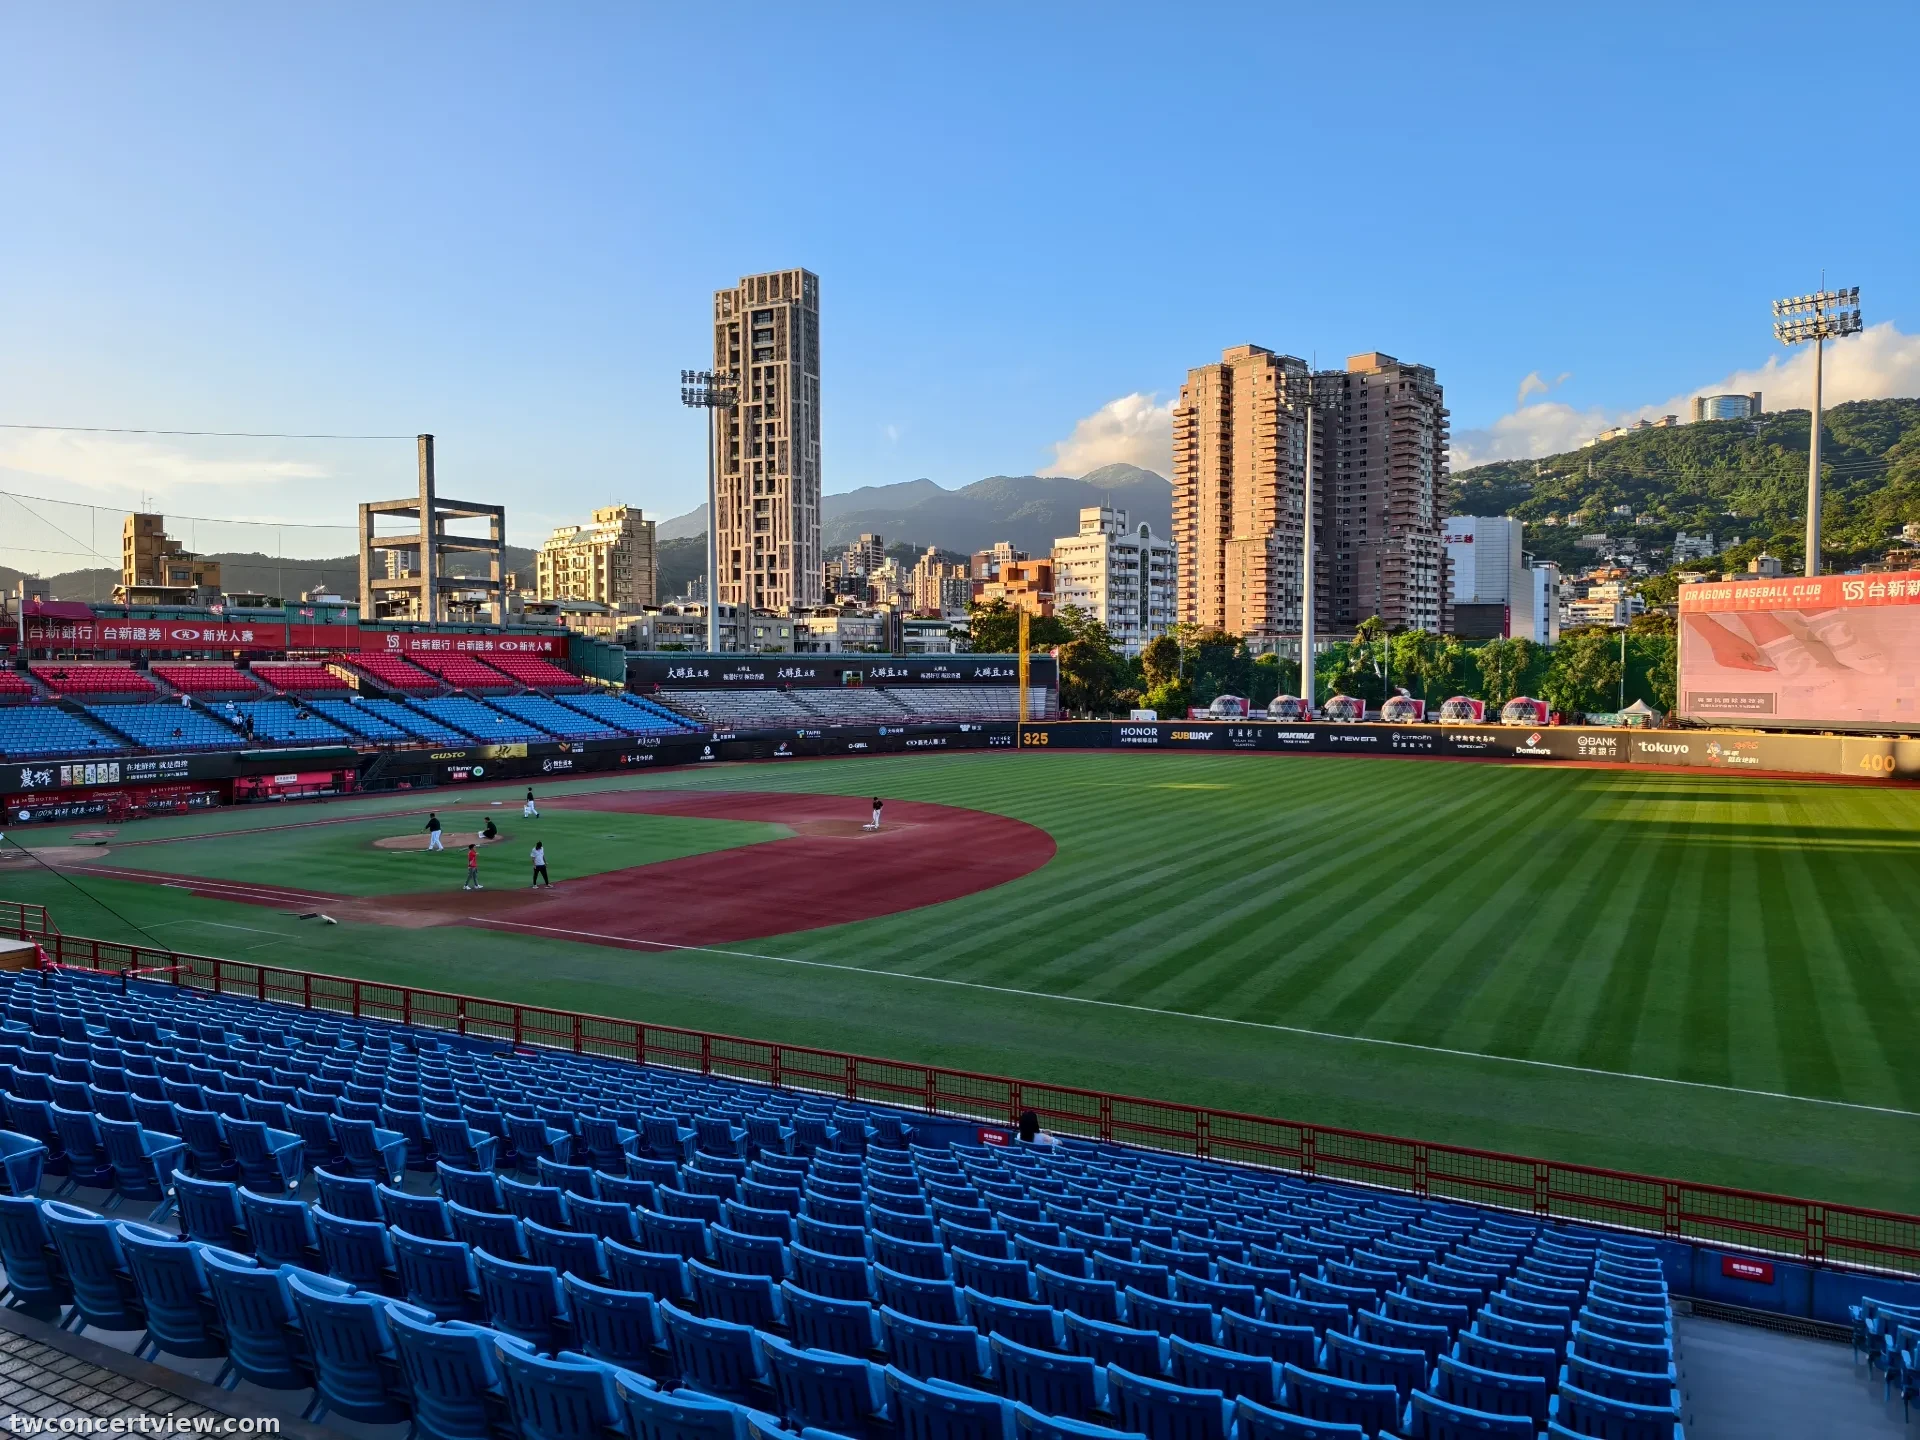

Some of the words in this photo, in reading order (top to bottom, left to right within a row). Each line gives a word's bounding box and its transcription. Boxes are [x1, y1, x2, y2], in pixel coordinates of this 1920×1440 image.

[1440, 534, 1474, 543] 光三越
[1685, 588, 1732, 601] DRAGONS
[1735, 586, 1788, 599] BASEBALL
[1792, 584, 1822, 596] CLUB
[29, 624, 92, 640] 台新銀行
[103, 626, 162, 641] 台新證券
[203, 629, 254, 642] 新光人壽
[411, 639, 451, 651] 台新銀行
[457, 640, 494, 651] 台新證券
[1120, 728, 1158, 736] HONOR
[1170, 731, 1214, 740] SUBWAY
[1023, 732, 1049, 745] 325
[1515, 746, 1551, 755] Domino's
[1578, 746, 1617, 756] 王道銀行
[1640, 741, 1689, 754] tokuyo
[430, 751, 466, 759] GUSTO
[1860, 754, 1896, 772] 400
